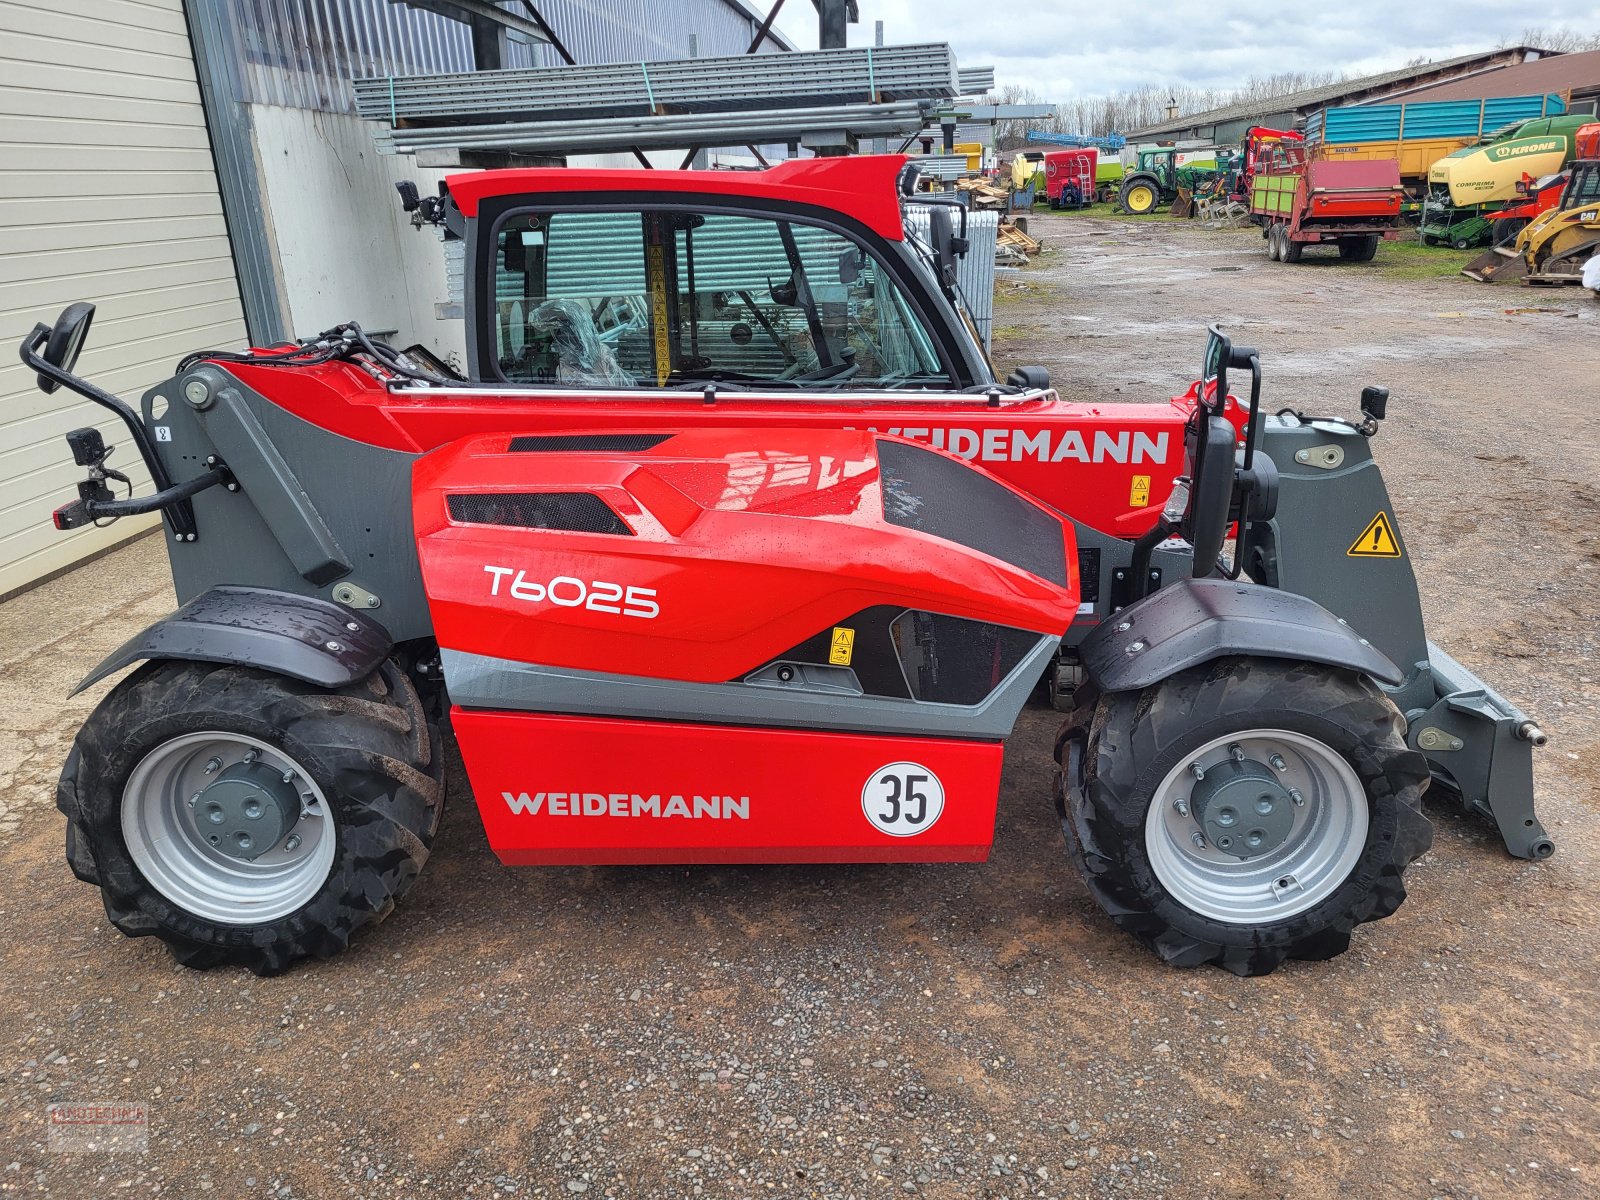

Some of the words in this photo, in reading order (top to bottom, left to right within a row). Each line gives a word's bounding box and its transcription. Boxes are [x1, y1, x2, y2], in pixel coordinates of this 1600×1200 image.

[1511, 142, 1556, 155] KRONE
[1580, 212, 1596, 221] CAT
[843, 427, 1169, 465] IDEMANN
[483, 565, 660, 619] T6025
[502, 792, 750, 820] WEIDEMANN
[878, 774, 928, 825] 35
